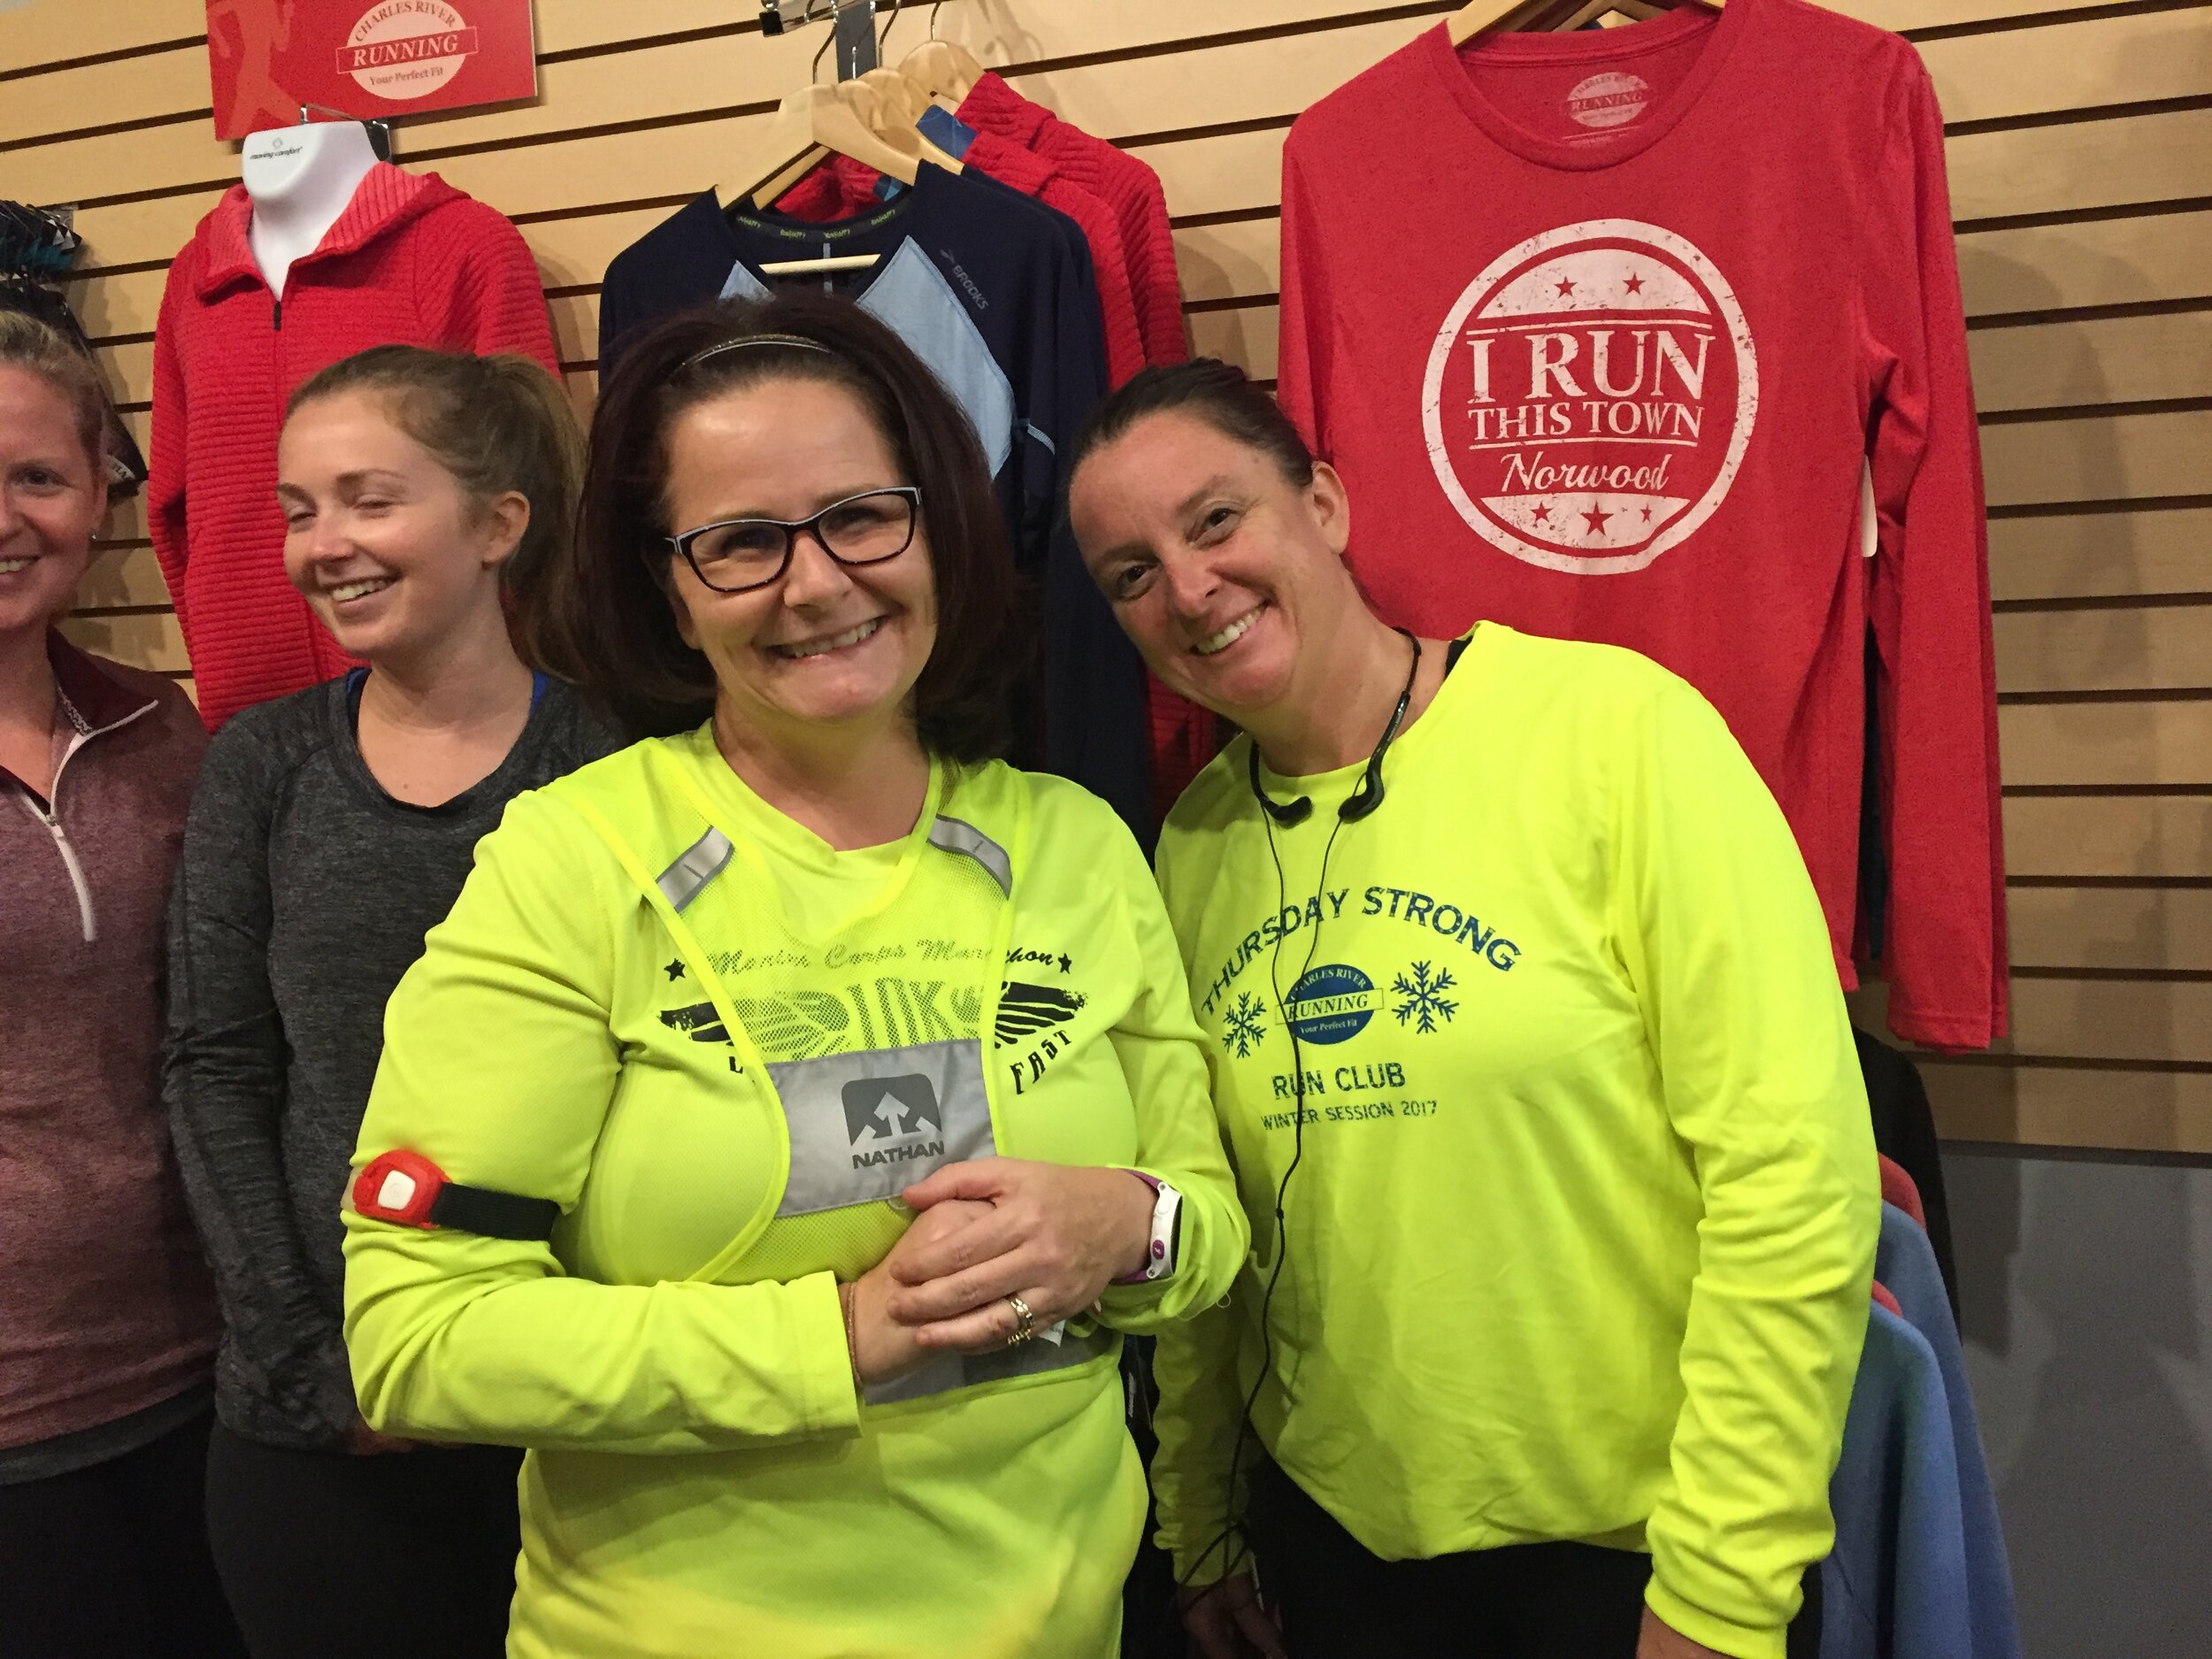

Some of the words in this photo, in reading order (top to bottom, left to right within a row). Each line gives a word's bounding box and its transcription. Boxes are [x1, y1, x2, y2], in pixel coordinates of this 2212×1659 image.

[355, 1, 412, 42] CHARLES
[415, 0, 457, 28] RIVER
[352, 34, 458, 67] RUNNING
[369, 74, 394, 86] Your
[395, 69, 429, 82] Perfect
[431, 66, 444, 77] Fit
[952, 264, 989, 310] BROOKS
[1465, 337, 1497, 404] I
[1525, 329, 1717, 401] RUN
[1468, 403, 1572, 442] THIS
[1582, 400, 1706, 439] TOWN
[1499, 452, 1673, 493] Norwood
[1201, 887, 1350, 1016] THURSDAY
[1361, 886, 1522, 972] STRONG
[1290, 969, 1335, 1002] CARLES
[1336, 967, 1367, 989] RIVER
[1009, 1029, 1072, 1095] FAST
[1271, 1070, 1326, 1101] RUN
[1334, 1062, 1406, 1092] CLUB
[1261, 1109, 1321, 1131] WINTER
[1325, 1102, 1395, 1122] SESSION
[1399, 1100, 1438, 1118] 2017
[852, 1141, 946, 1170] NATHAN
